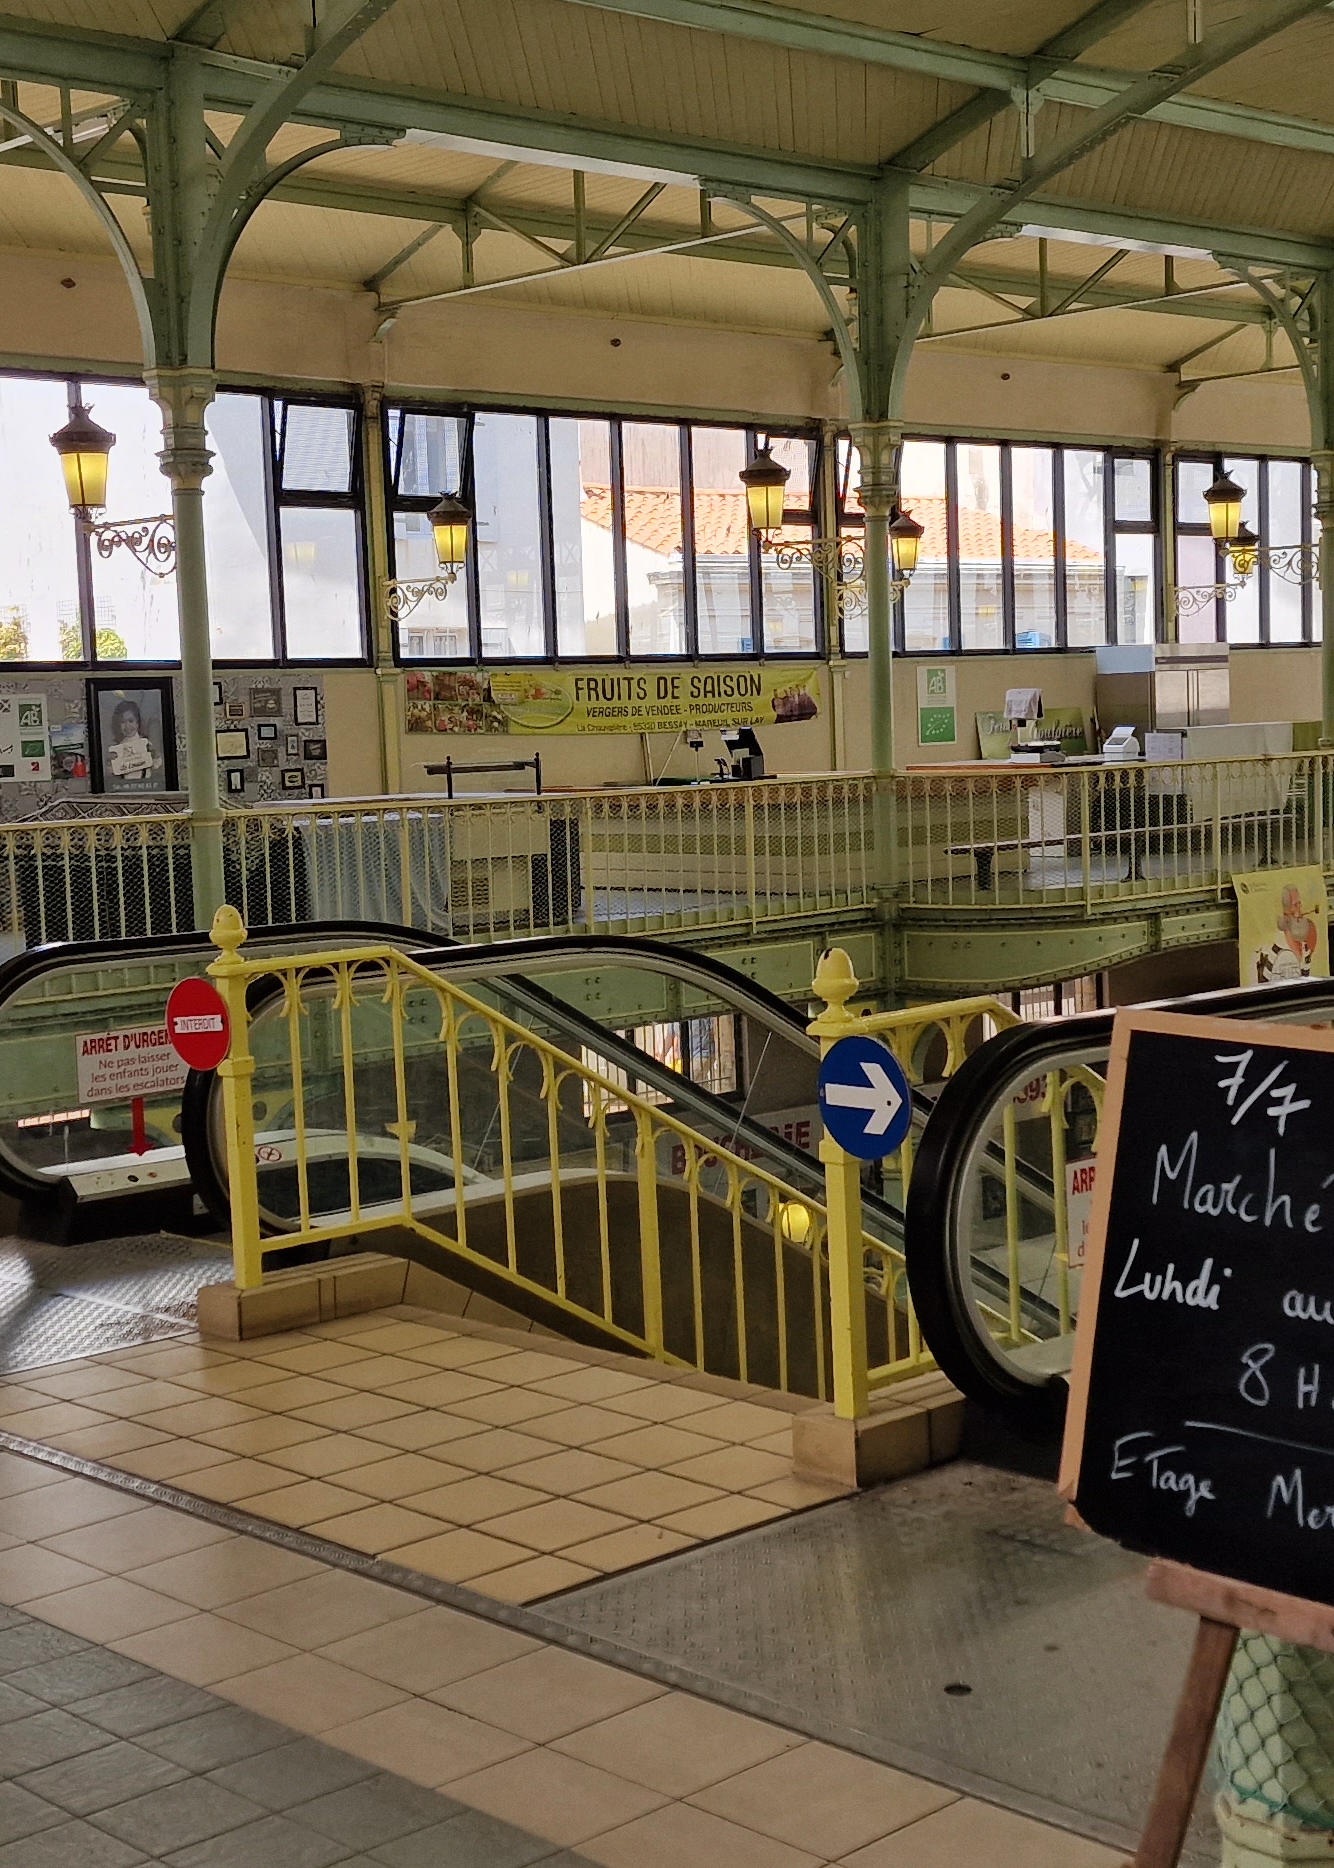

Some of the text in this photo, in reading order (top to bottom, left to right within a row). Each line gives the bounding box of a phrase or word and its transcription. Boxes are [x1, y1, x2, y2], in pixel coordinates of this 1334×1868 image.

[574, 674, 763, 702] FRUITS DE SAISON
[928, 676, 945, 694] AB
[585, 706, 629, 718] VERGERS
[631, 705, 644, 716] DE
[645, 701, 682, 716] VENDÉE
[689, 701, 754, 714] PRODUCTEURS
[657, 720, 688, 730] BESSAY
[180, 1017, 216, 1031] INTERDIT
[81, 1028, 172, 1057] ARRÊT D'URGEN
[98, 1051, 173, 1071] Ne pas laisser
[91, 1062, 180, 1083] les enfants jouer
[86, 1074, 186, 1098] dans les escalators
[1213, 1049, 1312, 1137] 7/7
